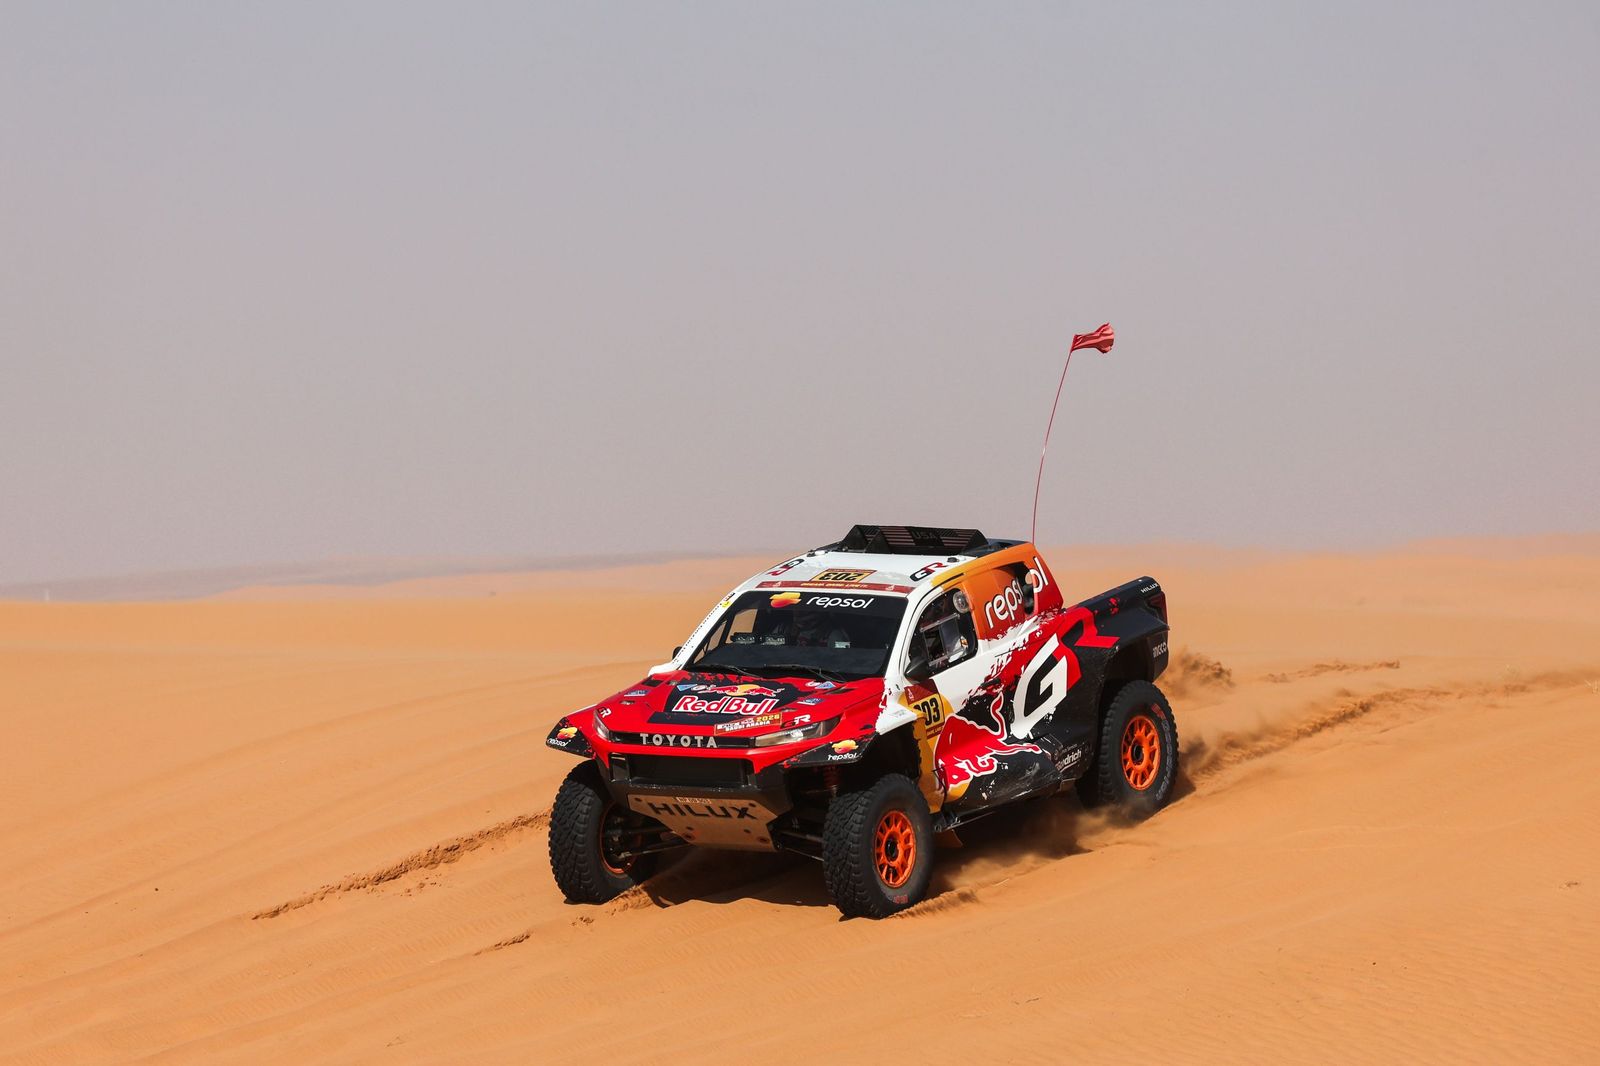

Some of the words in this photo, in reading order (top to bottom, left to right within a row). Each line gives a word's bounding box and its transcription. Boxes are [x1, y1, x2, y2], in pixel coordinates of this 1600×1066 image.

[911, 531, 938, 540] USA
[909, 562, 948, 582] GR
[1140, 583, 1159, 594] HILUX
[806, 596, 875, 609] repsol
[671, 695, 732, 713] Red
[721, 696, 780, 715] Bull
[639, 733, 718, 748] TOYOTA
[827, 752, 858, 761] repsol
[647, 802, 758, 820] HILUX
